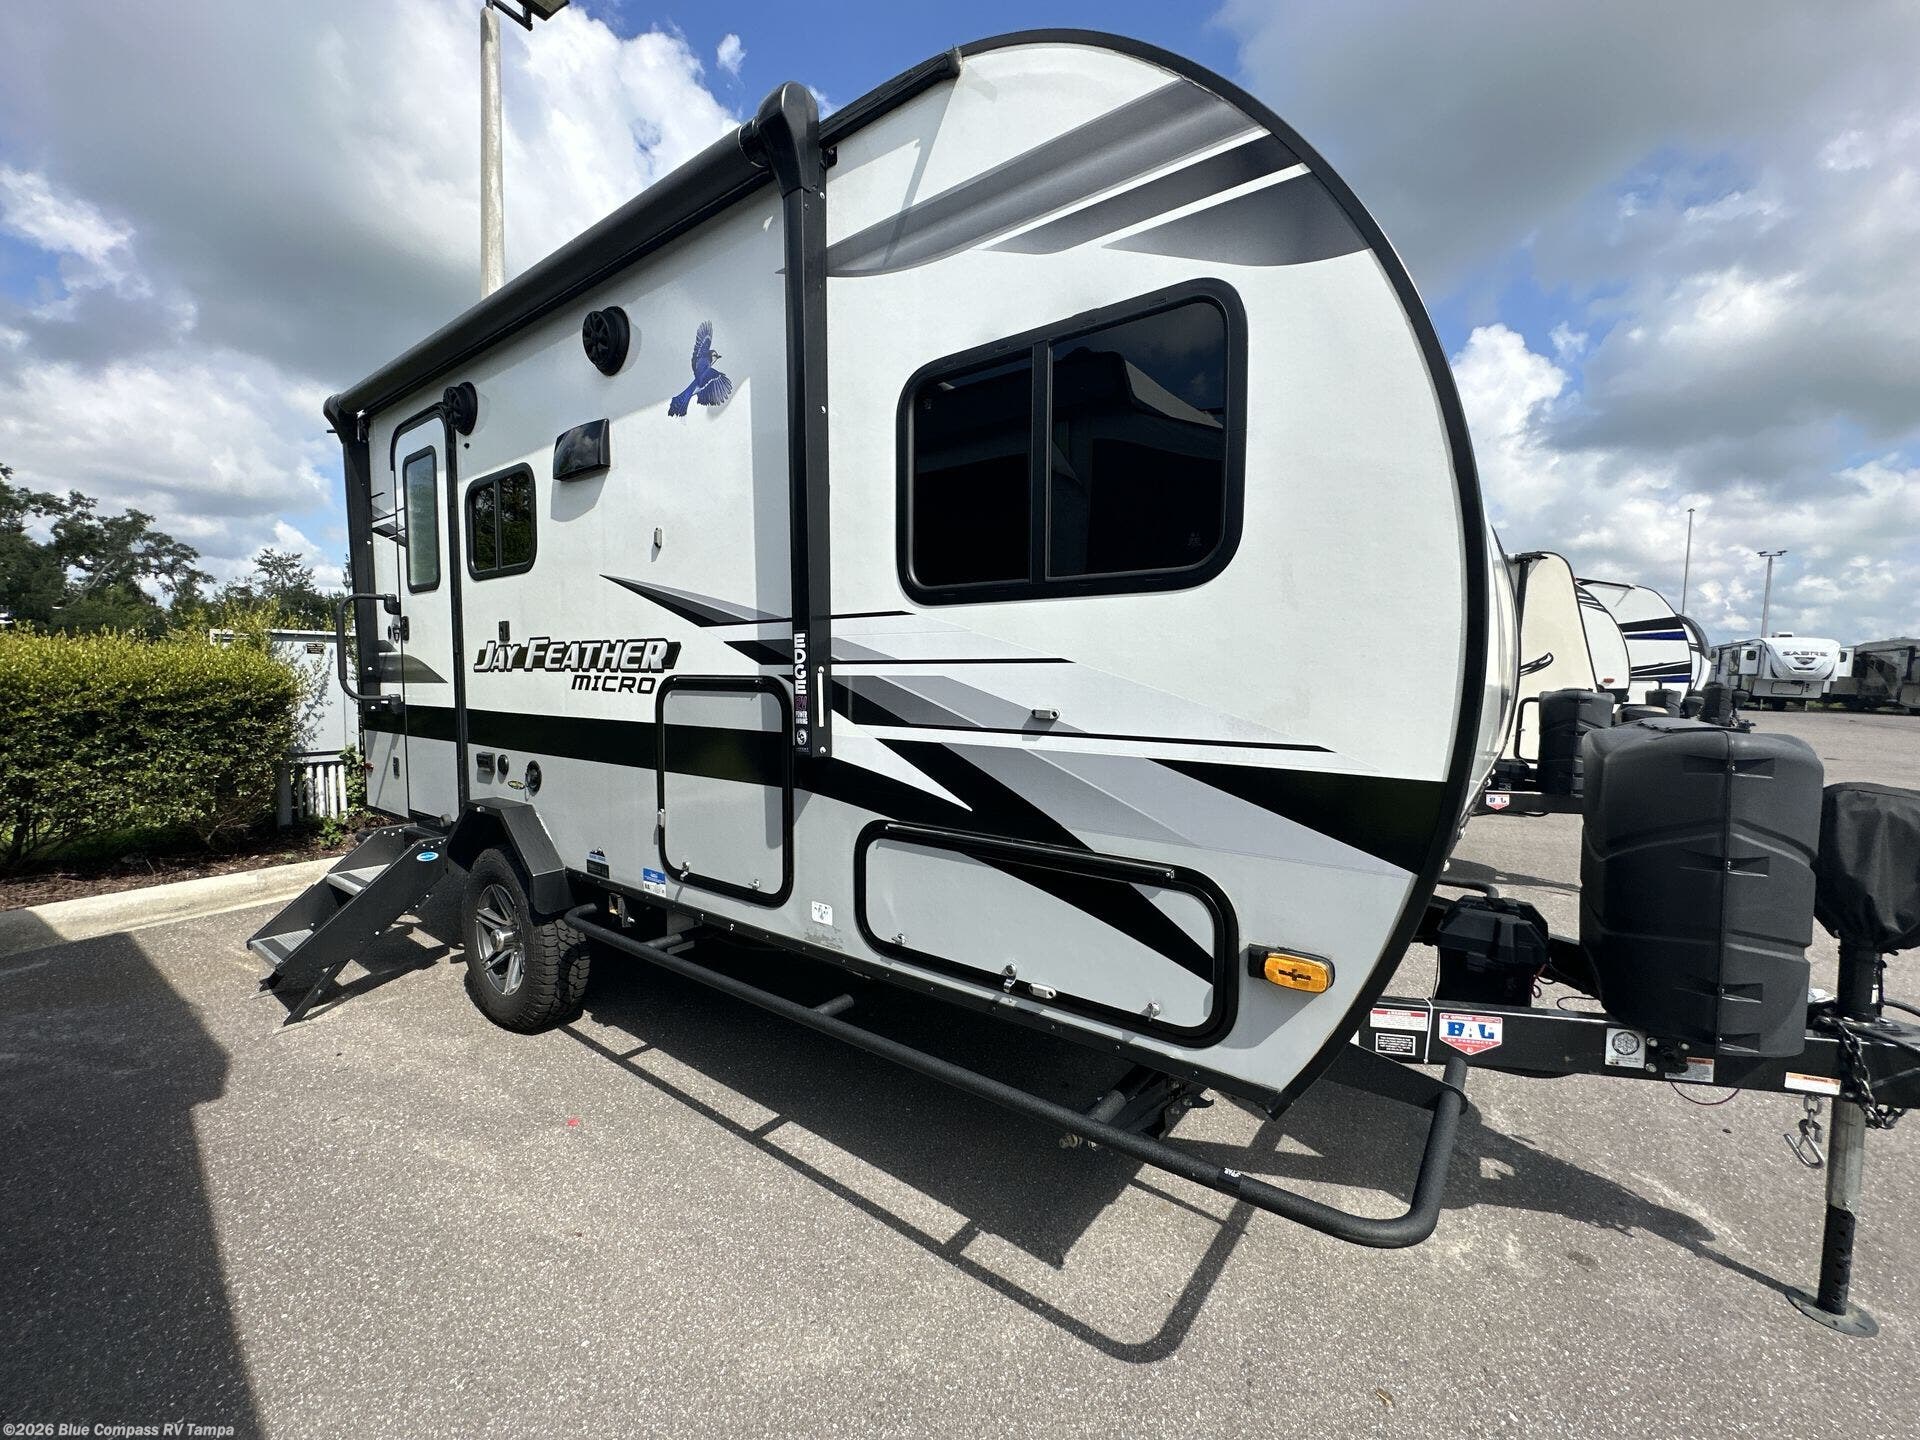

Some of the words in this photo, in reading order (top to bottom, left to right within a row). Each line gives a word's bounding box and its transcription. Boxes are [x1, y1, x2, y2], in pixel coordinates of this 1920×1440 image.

[474, 640, 520, 673] JAY
[523, 636, 670, 673] FEATHER
[794, 633, 807, 695] EDGE
[571, 674, 656, 694] MICRO
